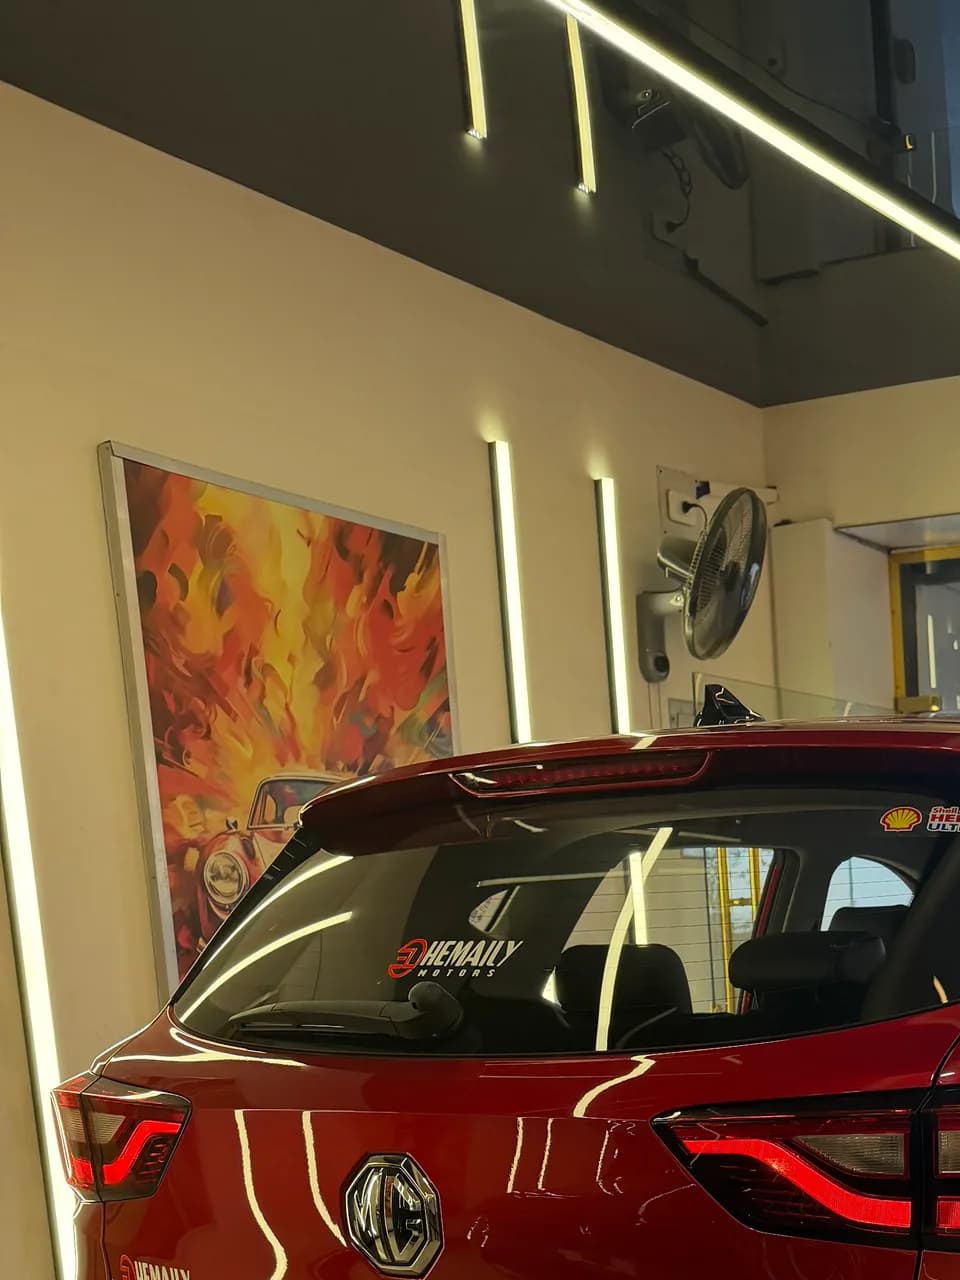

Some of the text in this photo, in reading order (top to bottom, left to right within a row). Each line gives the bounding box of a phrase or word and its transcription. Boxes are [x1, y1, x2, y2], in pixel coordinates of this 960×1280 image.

[932, 807, 959, 815] Shell
[417, 969, 496, 977] MOTORS
[352, 1165, 426, 1264] MG
